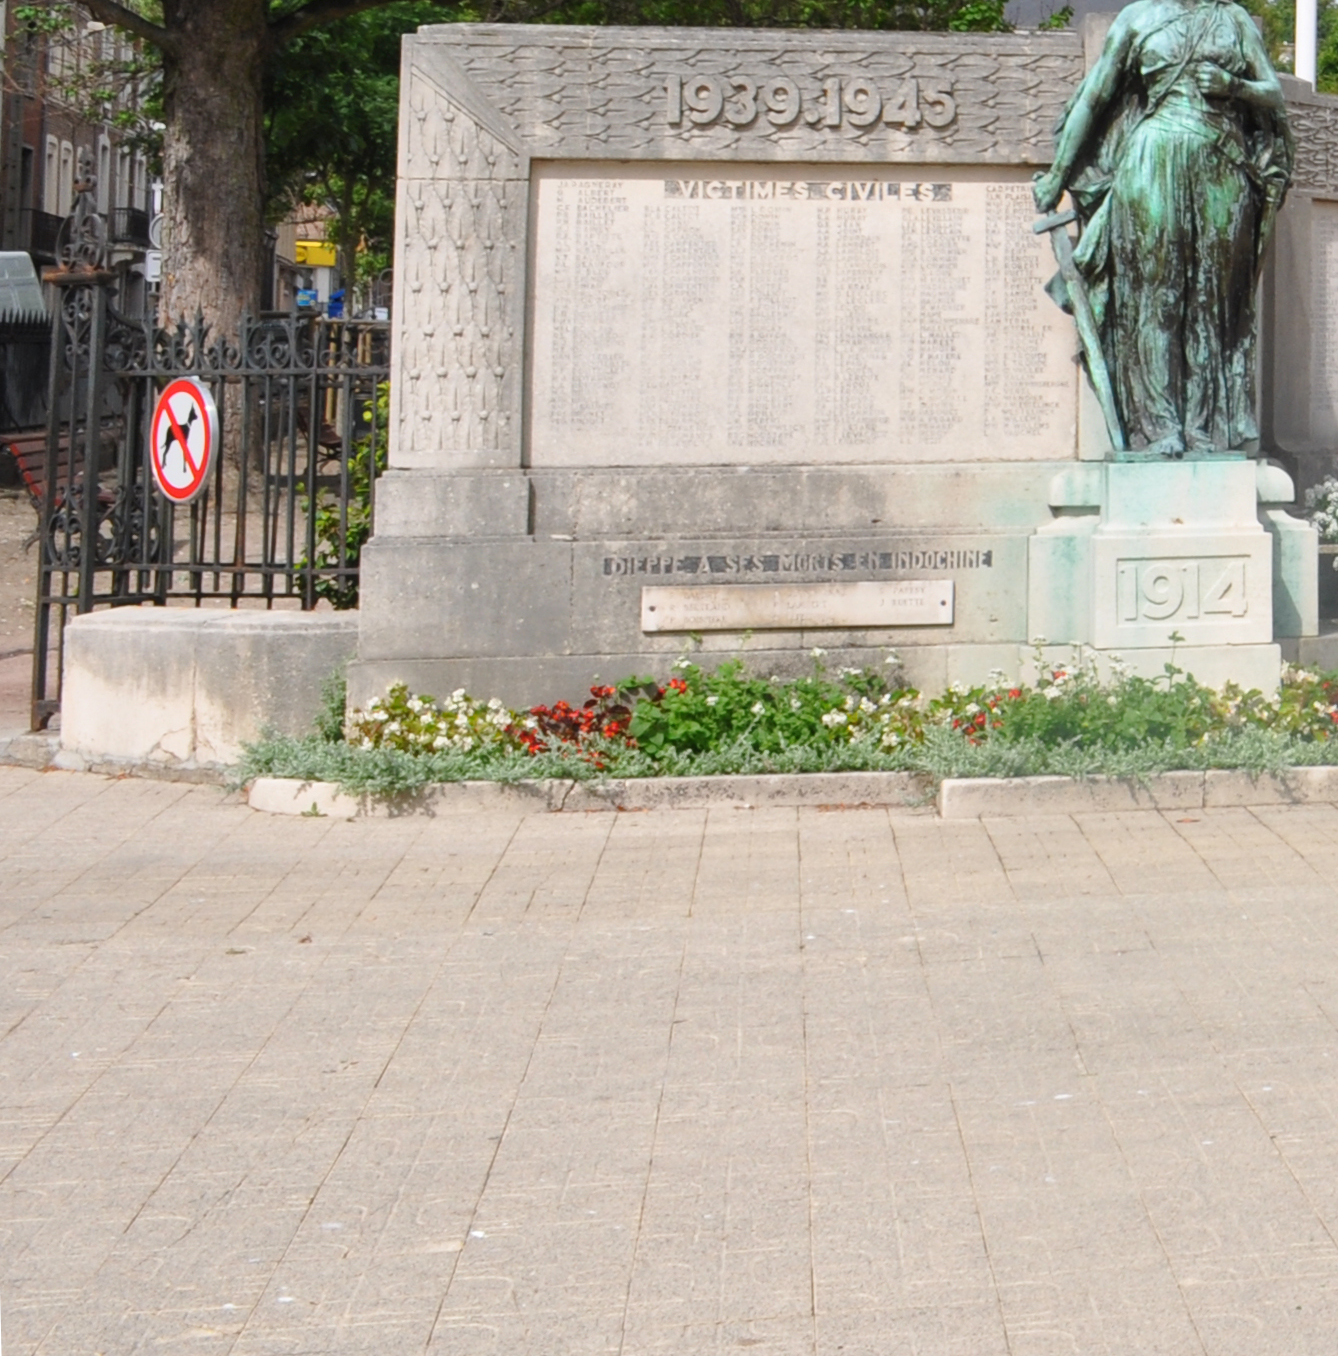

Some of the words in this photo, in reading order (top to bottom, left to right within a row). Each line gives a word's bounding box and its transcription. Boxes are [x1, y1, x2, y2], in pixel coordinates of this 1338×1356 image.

[678, 181, 809, 200] VICTIMES
[826, 182, 935, 201] CIVILES
[611, 556, 682, 575] DIEPPE
[725, 555, 764, 572] SES
[779, 554, 845, 571] MORTS
[857, 553, 880, 570] EN
[891, 550, 988, 569] INDOCHINE
[1118, 561, 1249, 621] 1914
